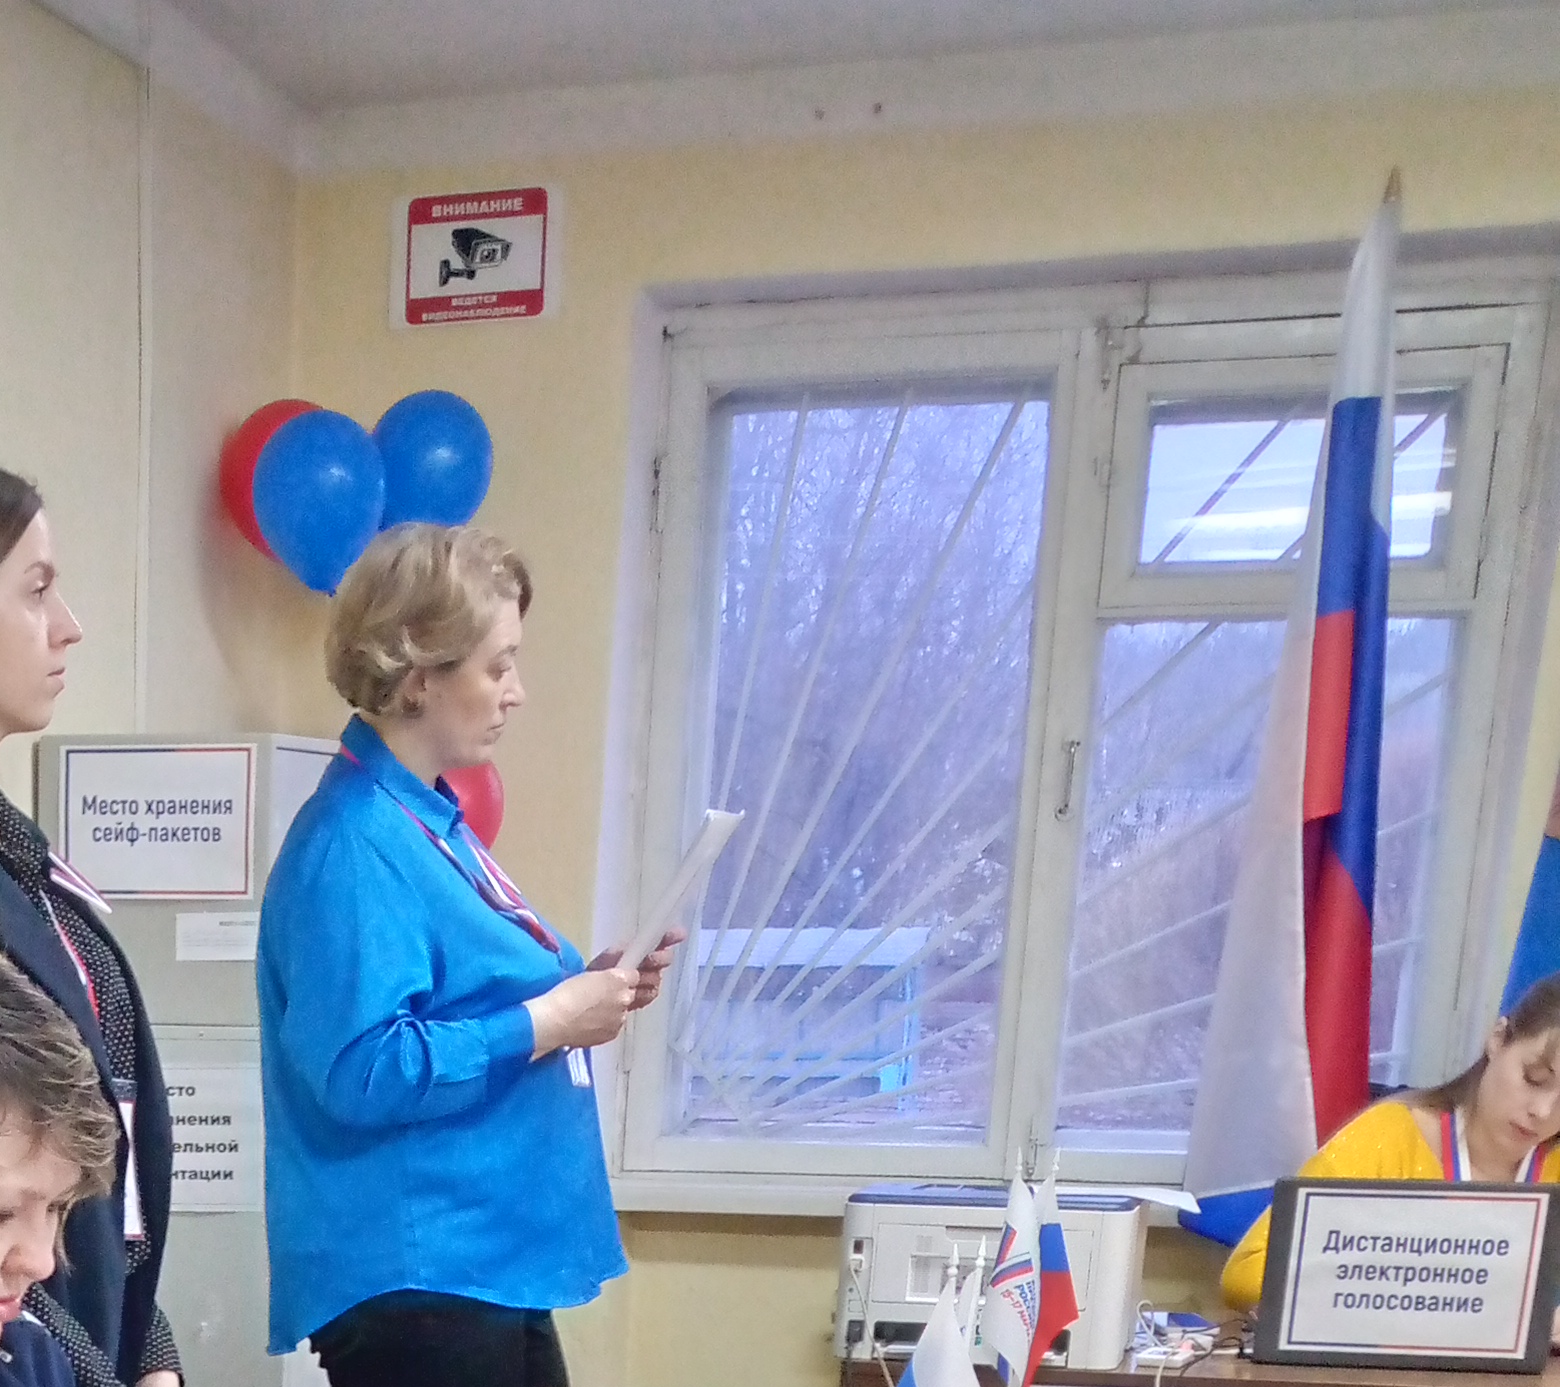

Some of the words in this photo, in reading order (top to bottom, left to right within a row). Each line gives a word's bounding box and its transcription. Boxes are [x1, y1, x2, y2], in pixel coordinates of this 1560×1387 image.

[432, 197, 523, 217] ВНИМАНИЕ
[81, 795, 139, 815] Место
[144, 799, 233, 819] хранения
[92, 821, 221, 847] сейф-пакетов
[166, 1086, 196, 1097] сто
[171, 1115, 232, 1126] нения
[1322, 1229, 1510, 1256] Дистанционное
[1335, 1263, 1489, 1287] электронное
[1332, 1292, 1484, 1314] голосование
